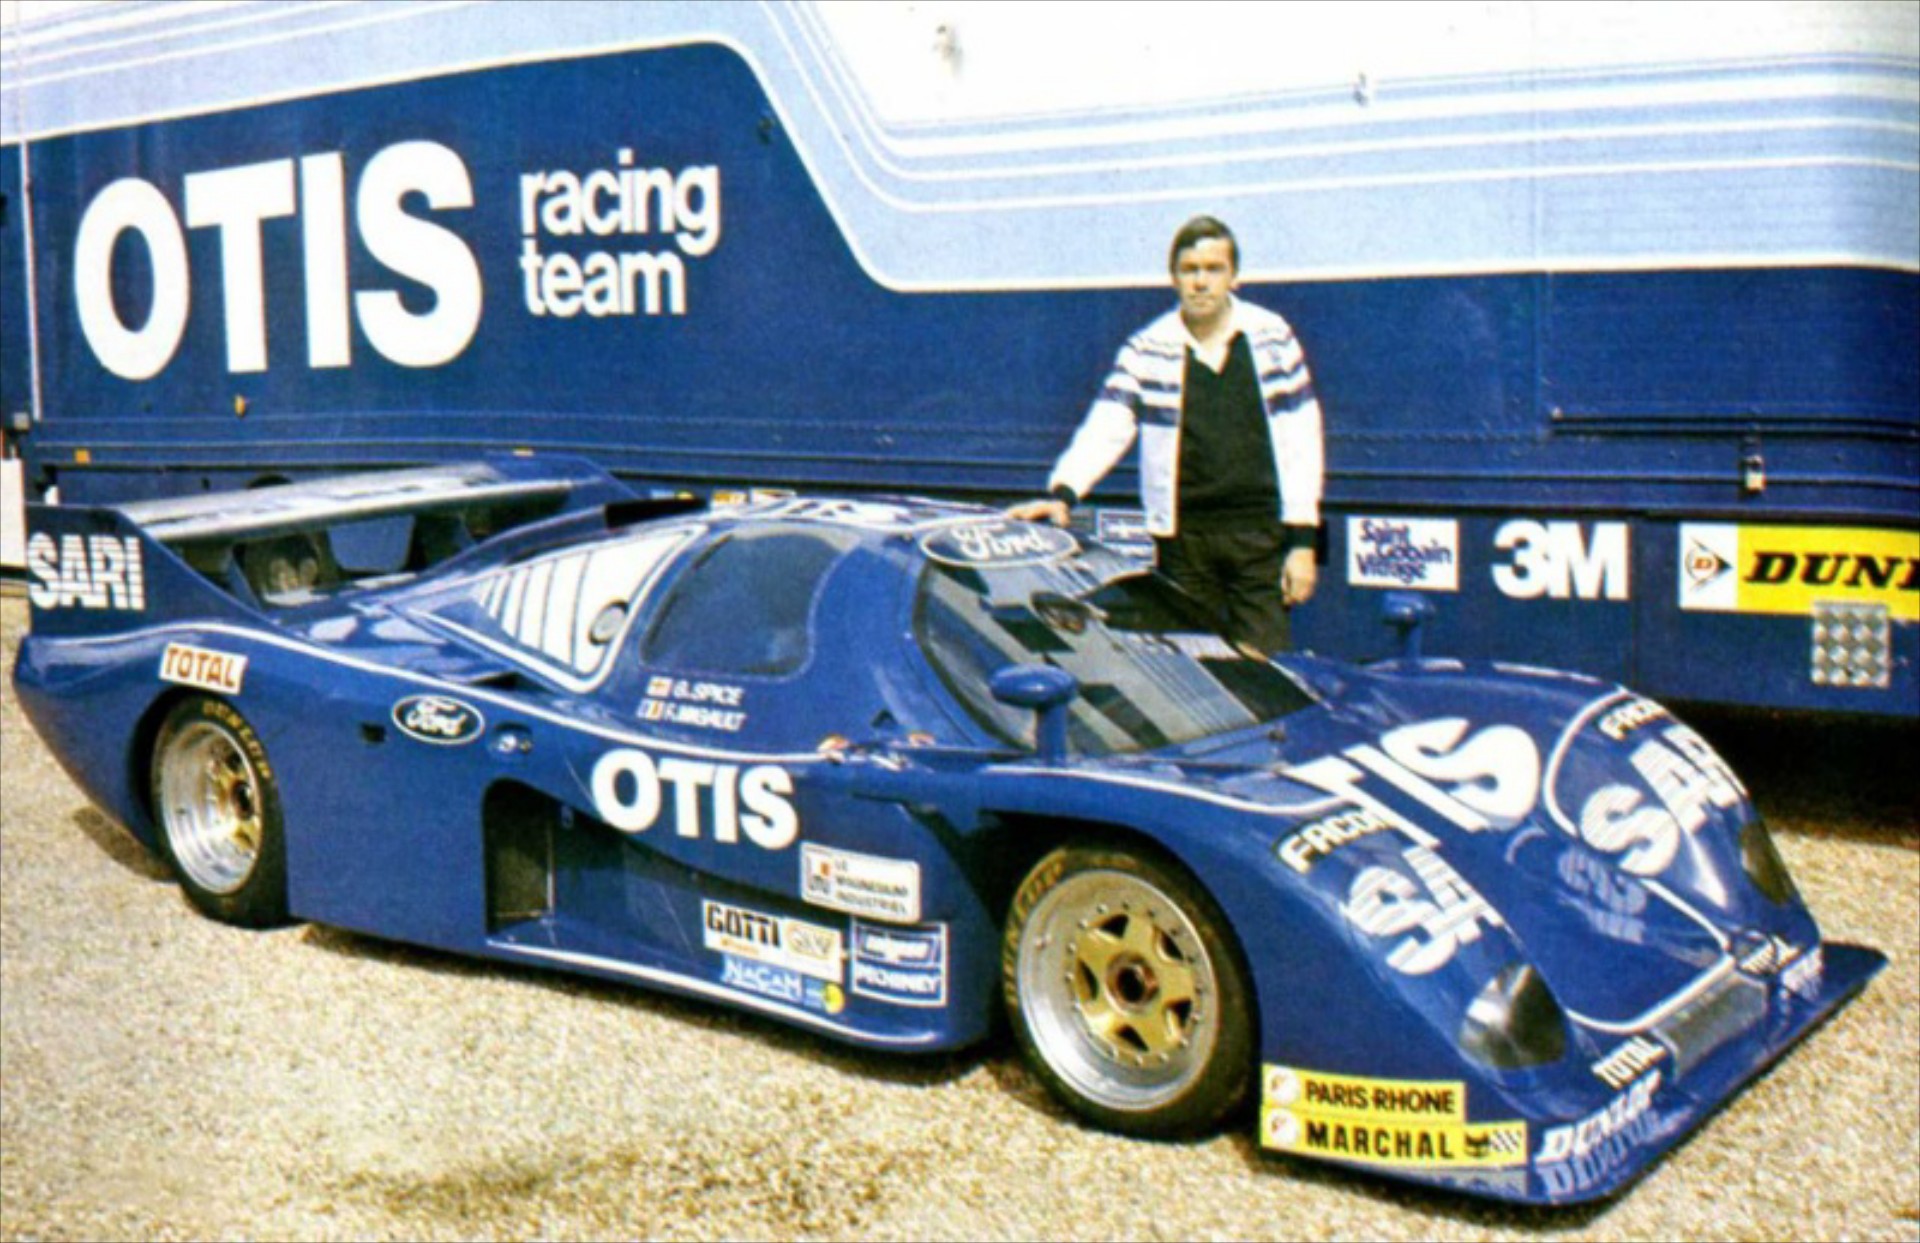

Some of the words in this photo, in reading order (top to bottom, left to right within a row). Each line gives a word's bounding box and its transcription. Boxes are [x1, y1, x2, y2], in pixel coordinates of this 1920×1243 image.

[520, 149, 721, 256] racing
[74, 140, 482, 381] OTIS
[520, 239, 687, 316] team
[28, 532, 145, 610] SARI
[952, 520, 1052, 561] Ford
[1492, 521, 1629, 599] 3M
[166, 647, 236, 688] TOTAL
[406, 700, 467, 736] Ford
[591, 749, 798, 850] OTIS
[706, 902, 780, 949] GOTTI
[1306, 1120, 1453, 1158] MARCHAL
